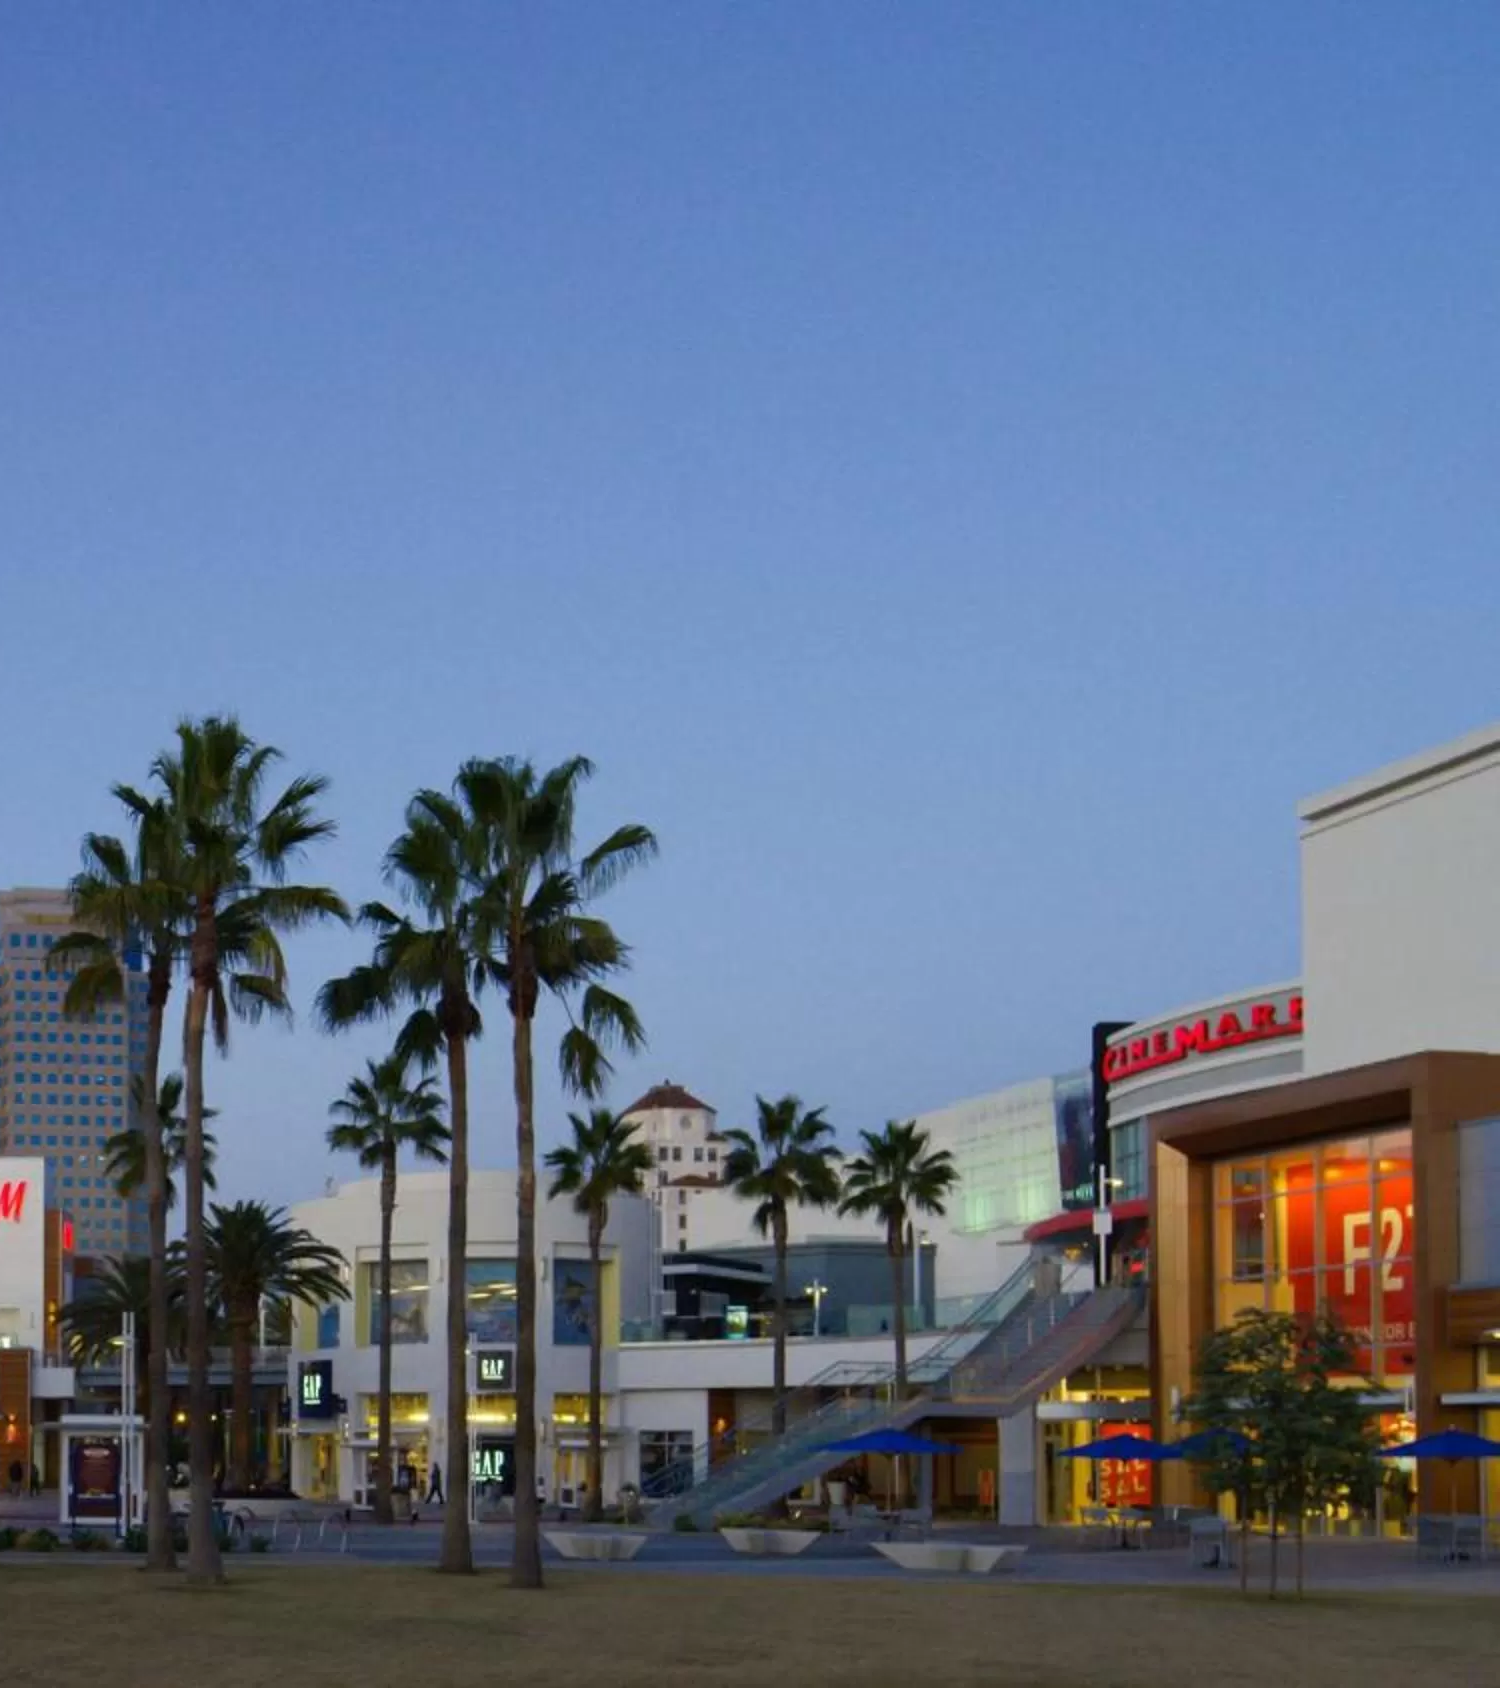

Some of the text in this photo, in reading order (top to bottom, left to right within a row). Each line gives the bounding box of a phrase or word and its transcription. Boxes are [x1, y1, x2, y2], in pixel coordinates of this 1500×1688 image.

[1343, 1206, 1414, 1296] F2
[481, 1359, 505, 1380] GAP
[472, 1450, 505, 1481] GAP
